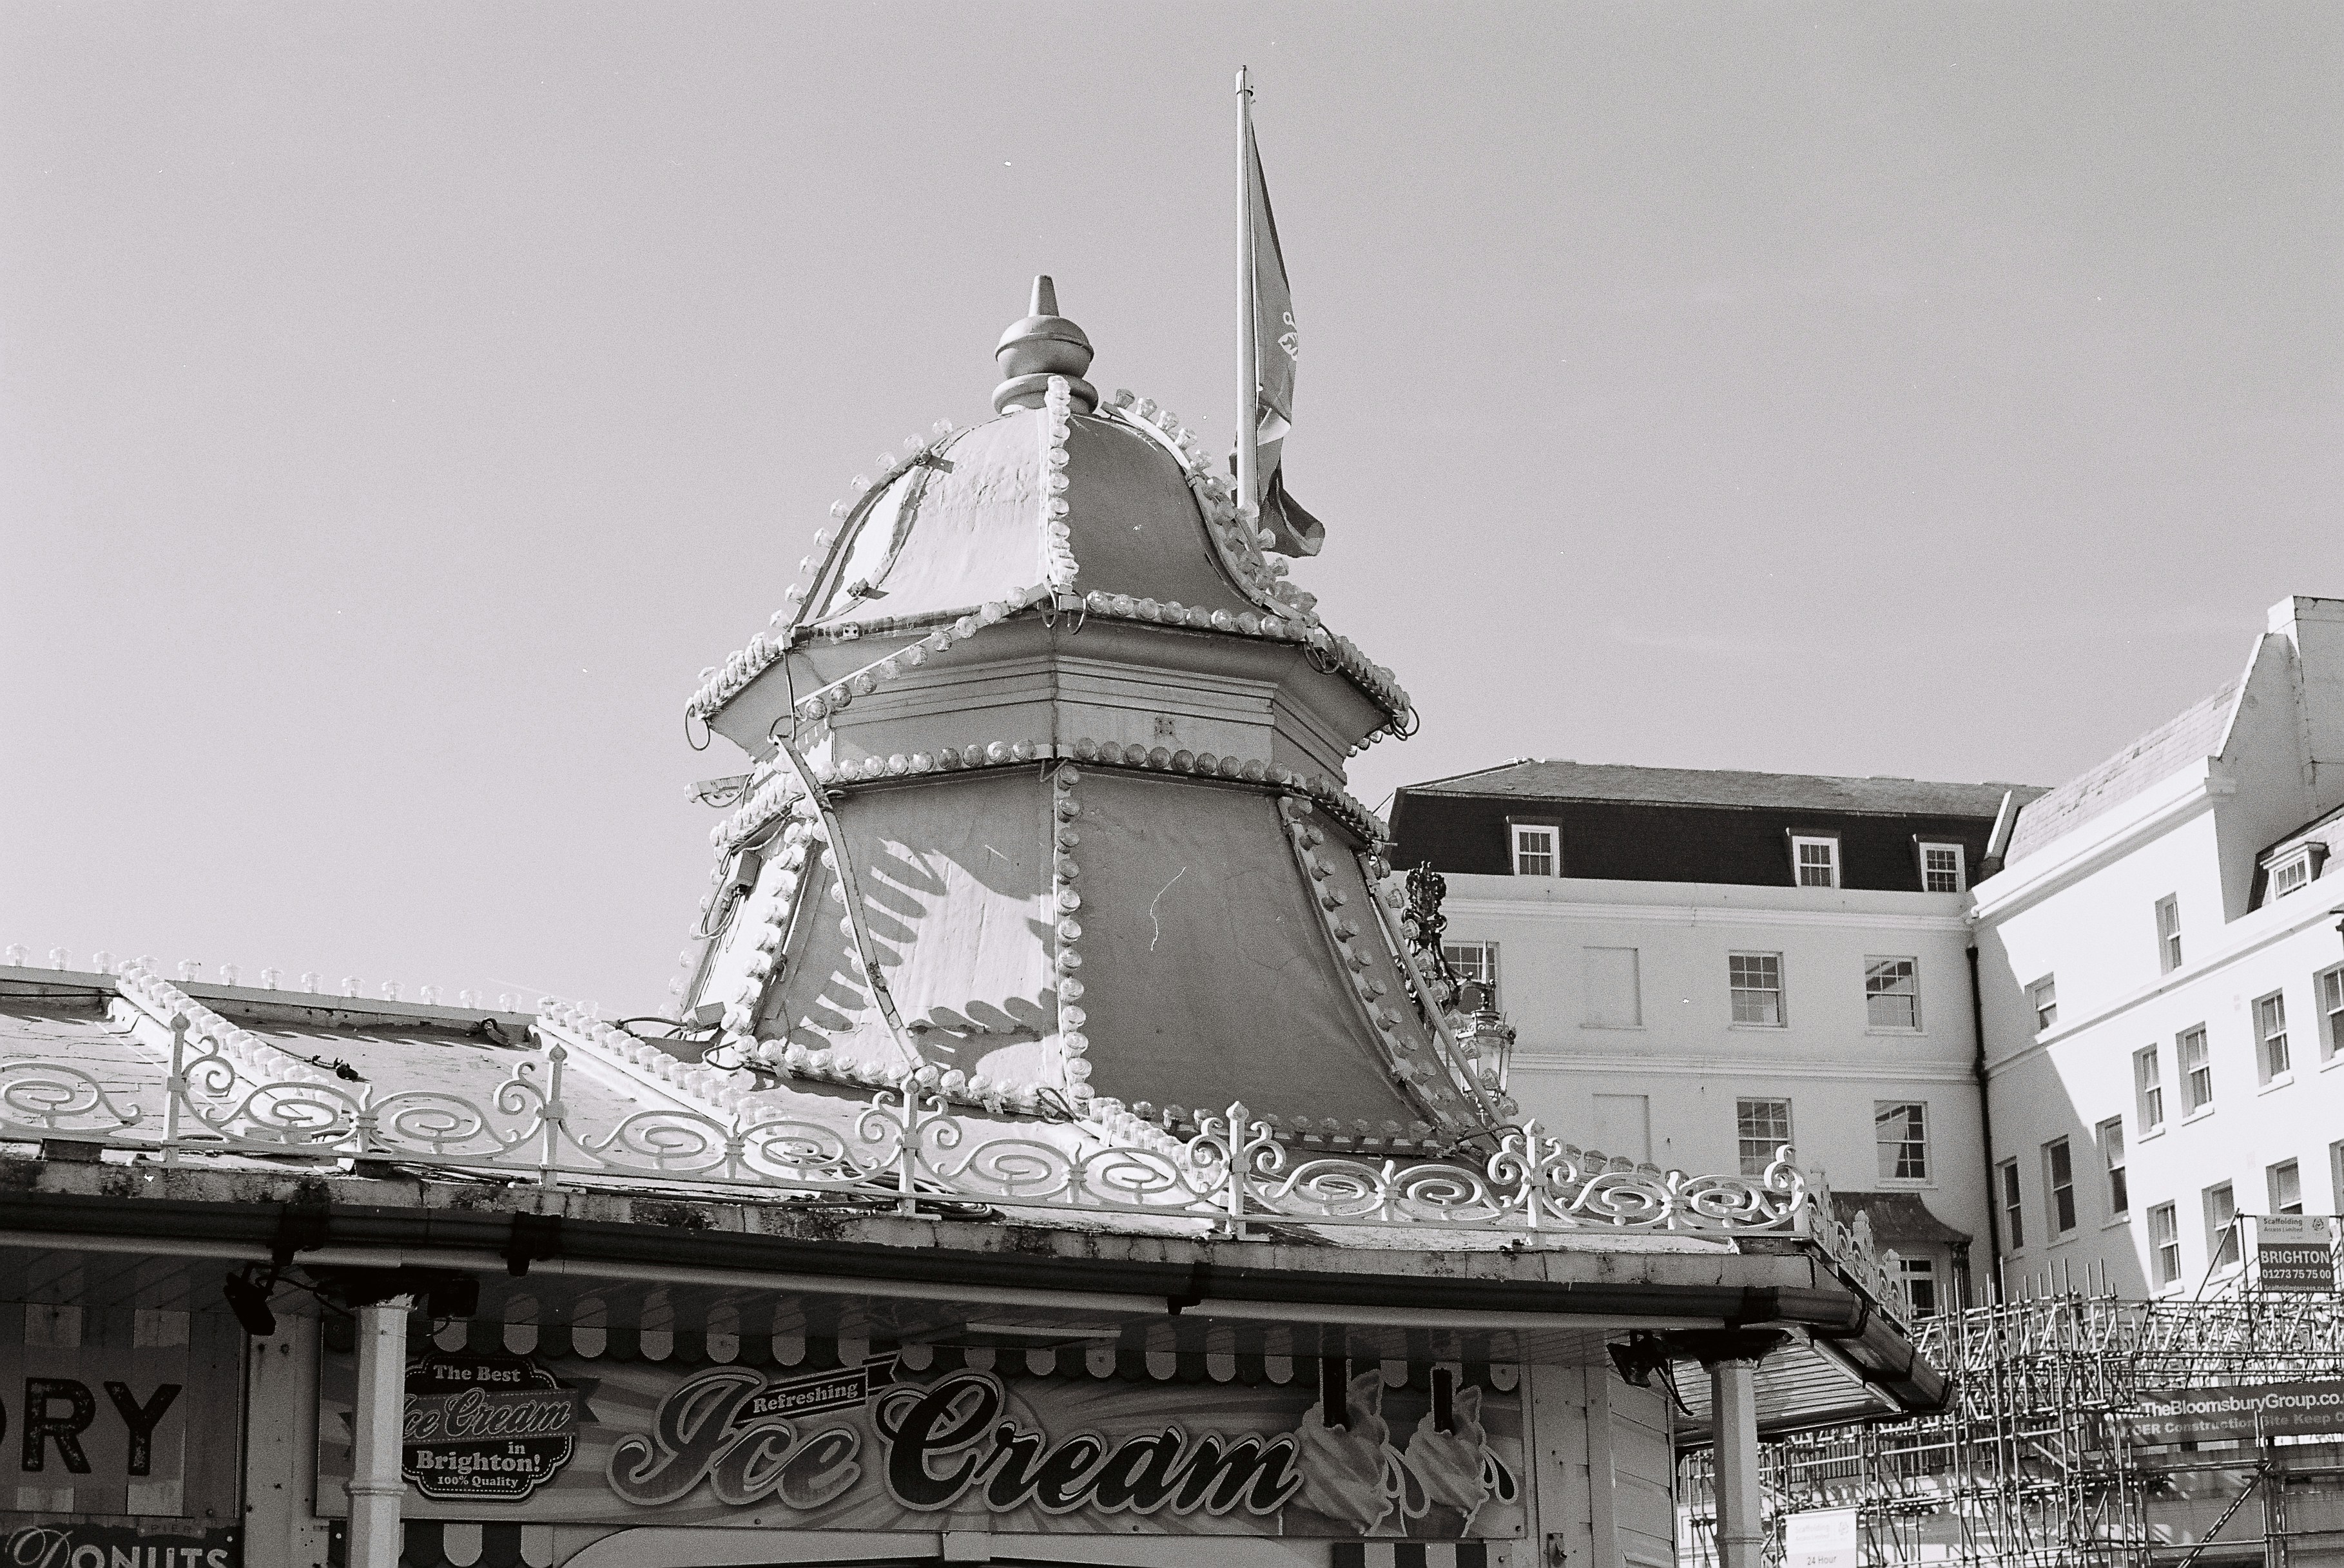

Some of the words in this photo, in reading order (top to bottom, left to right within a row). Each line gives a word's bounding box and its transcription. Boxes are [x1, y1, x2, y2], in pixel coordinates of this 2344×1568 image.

[2263, 1217, 2303, 1226] Scaffolding
[2260, 1250, 2330, 1263] BRIGHTON
[2262, 1269, 2291, 1279] 01273
[2292, 1269, 2305, 1279] 75
[2306, 1269, 2318, 1279] 75
[2320, 1269, 2332, 1279] 00
[433, 1364, 472, 1380] The
[476, 1366, 521, 1382] Best
[753, 1381, 858, 1413] Refreshing
[2142, 1393, 2344, 1417] TheBloomsburyGroup.co.
[444, 1387, 572, 1437] Cream
[0, 1377, 182, 1476] RY
[2164, 1418, 2255, 1434] Construction
[507, 1442, 525, 1454] in
[606, 1366, 862, 1509] Ice
[871, 1367, 1306, 1515] Cream
[416, 1450, 541, 1475] Brighton!
[438, 1475, 469, 1485] 100%
[472, 1475, 519, 1488] Quality
[1806, 1556, 1816, 1565] 24
[1817, 1556, 1837, 1565] Hour
